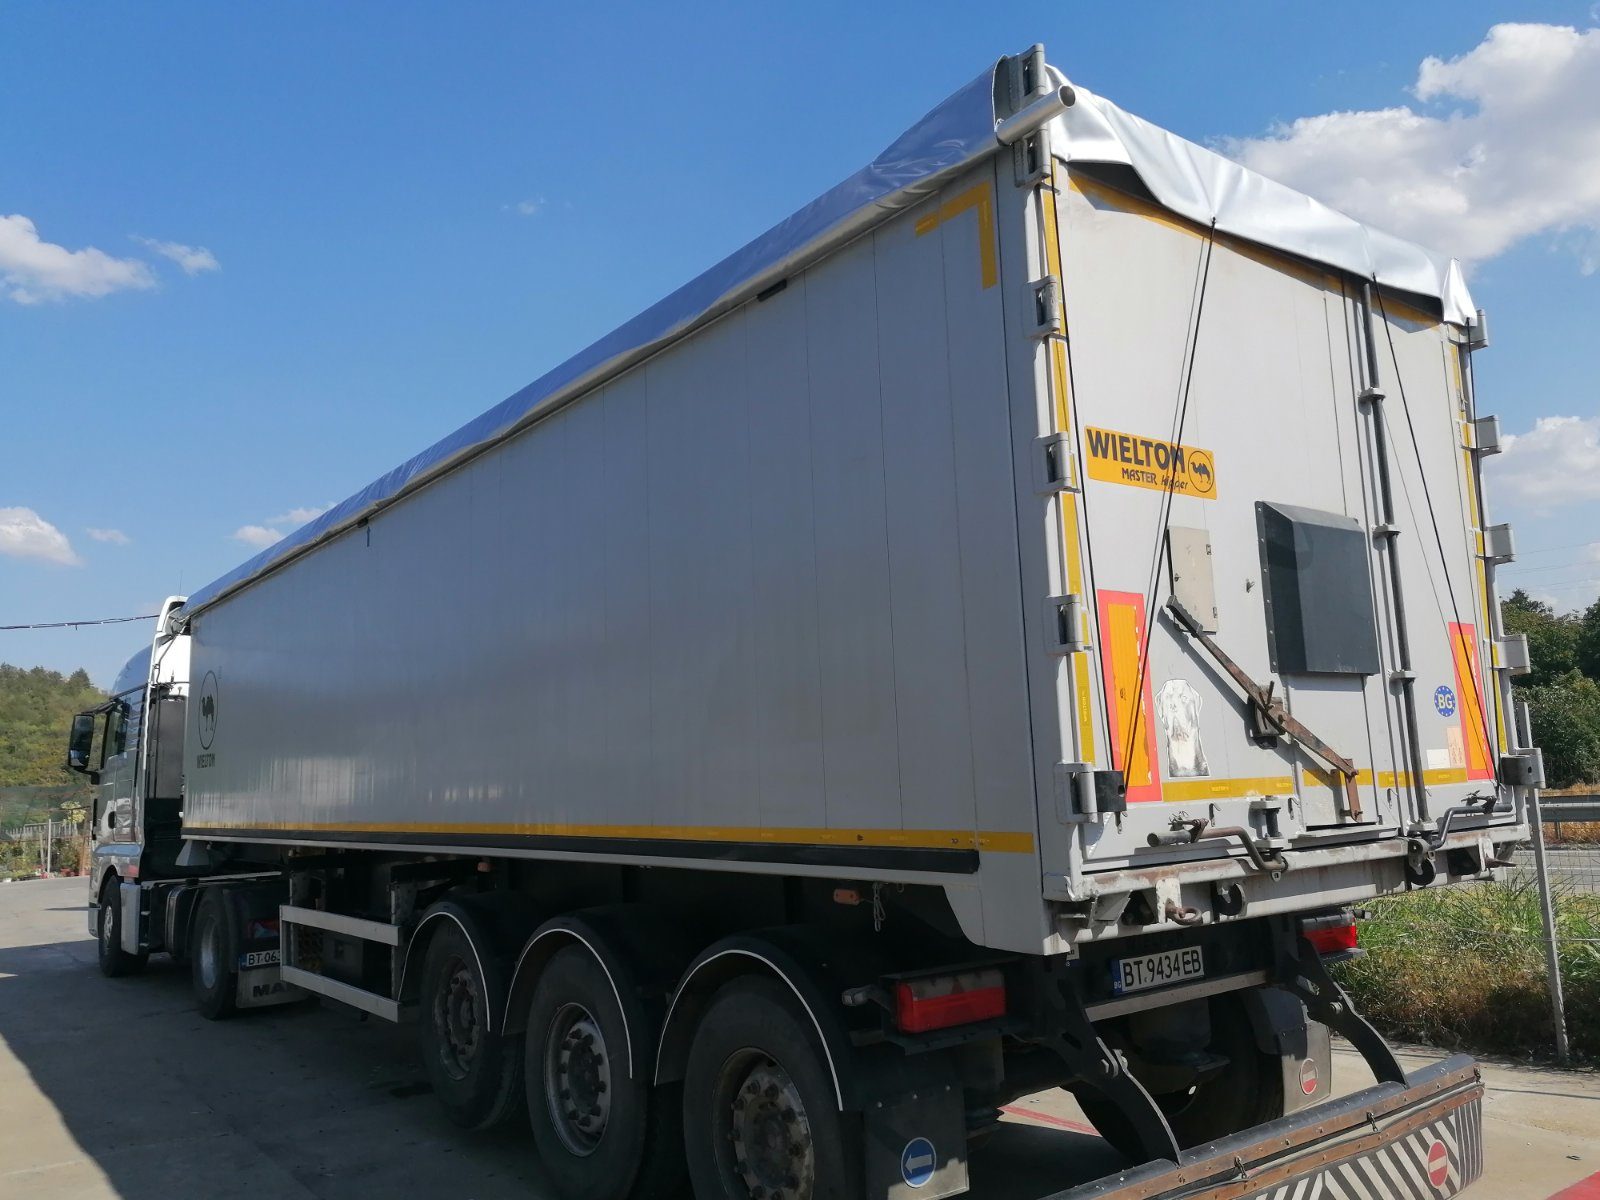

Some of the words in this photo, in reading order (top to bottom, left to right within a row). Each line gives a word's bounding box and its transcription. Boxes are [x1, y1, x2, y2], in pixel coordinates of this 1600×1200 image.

[1087, 429, 1185, 473] WIELTON
[1122, 467, 1158, 486] MASTER
[1438, 693, 1453, 708] BG
